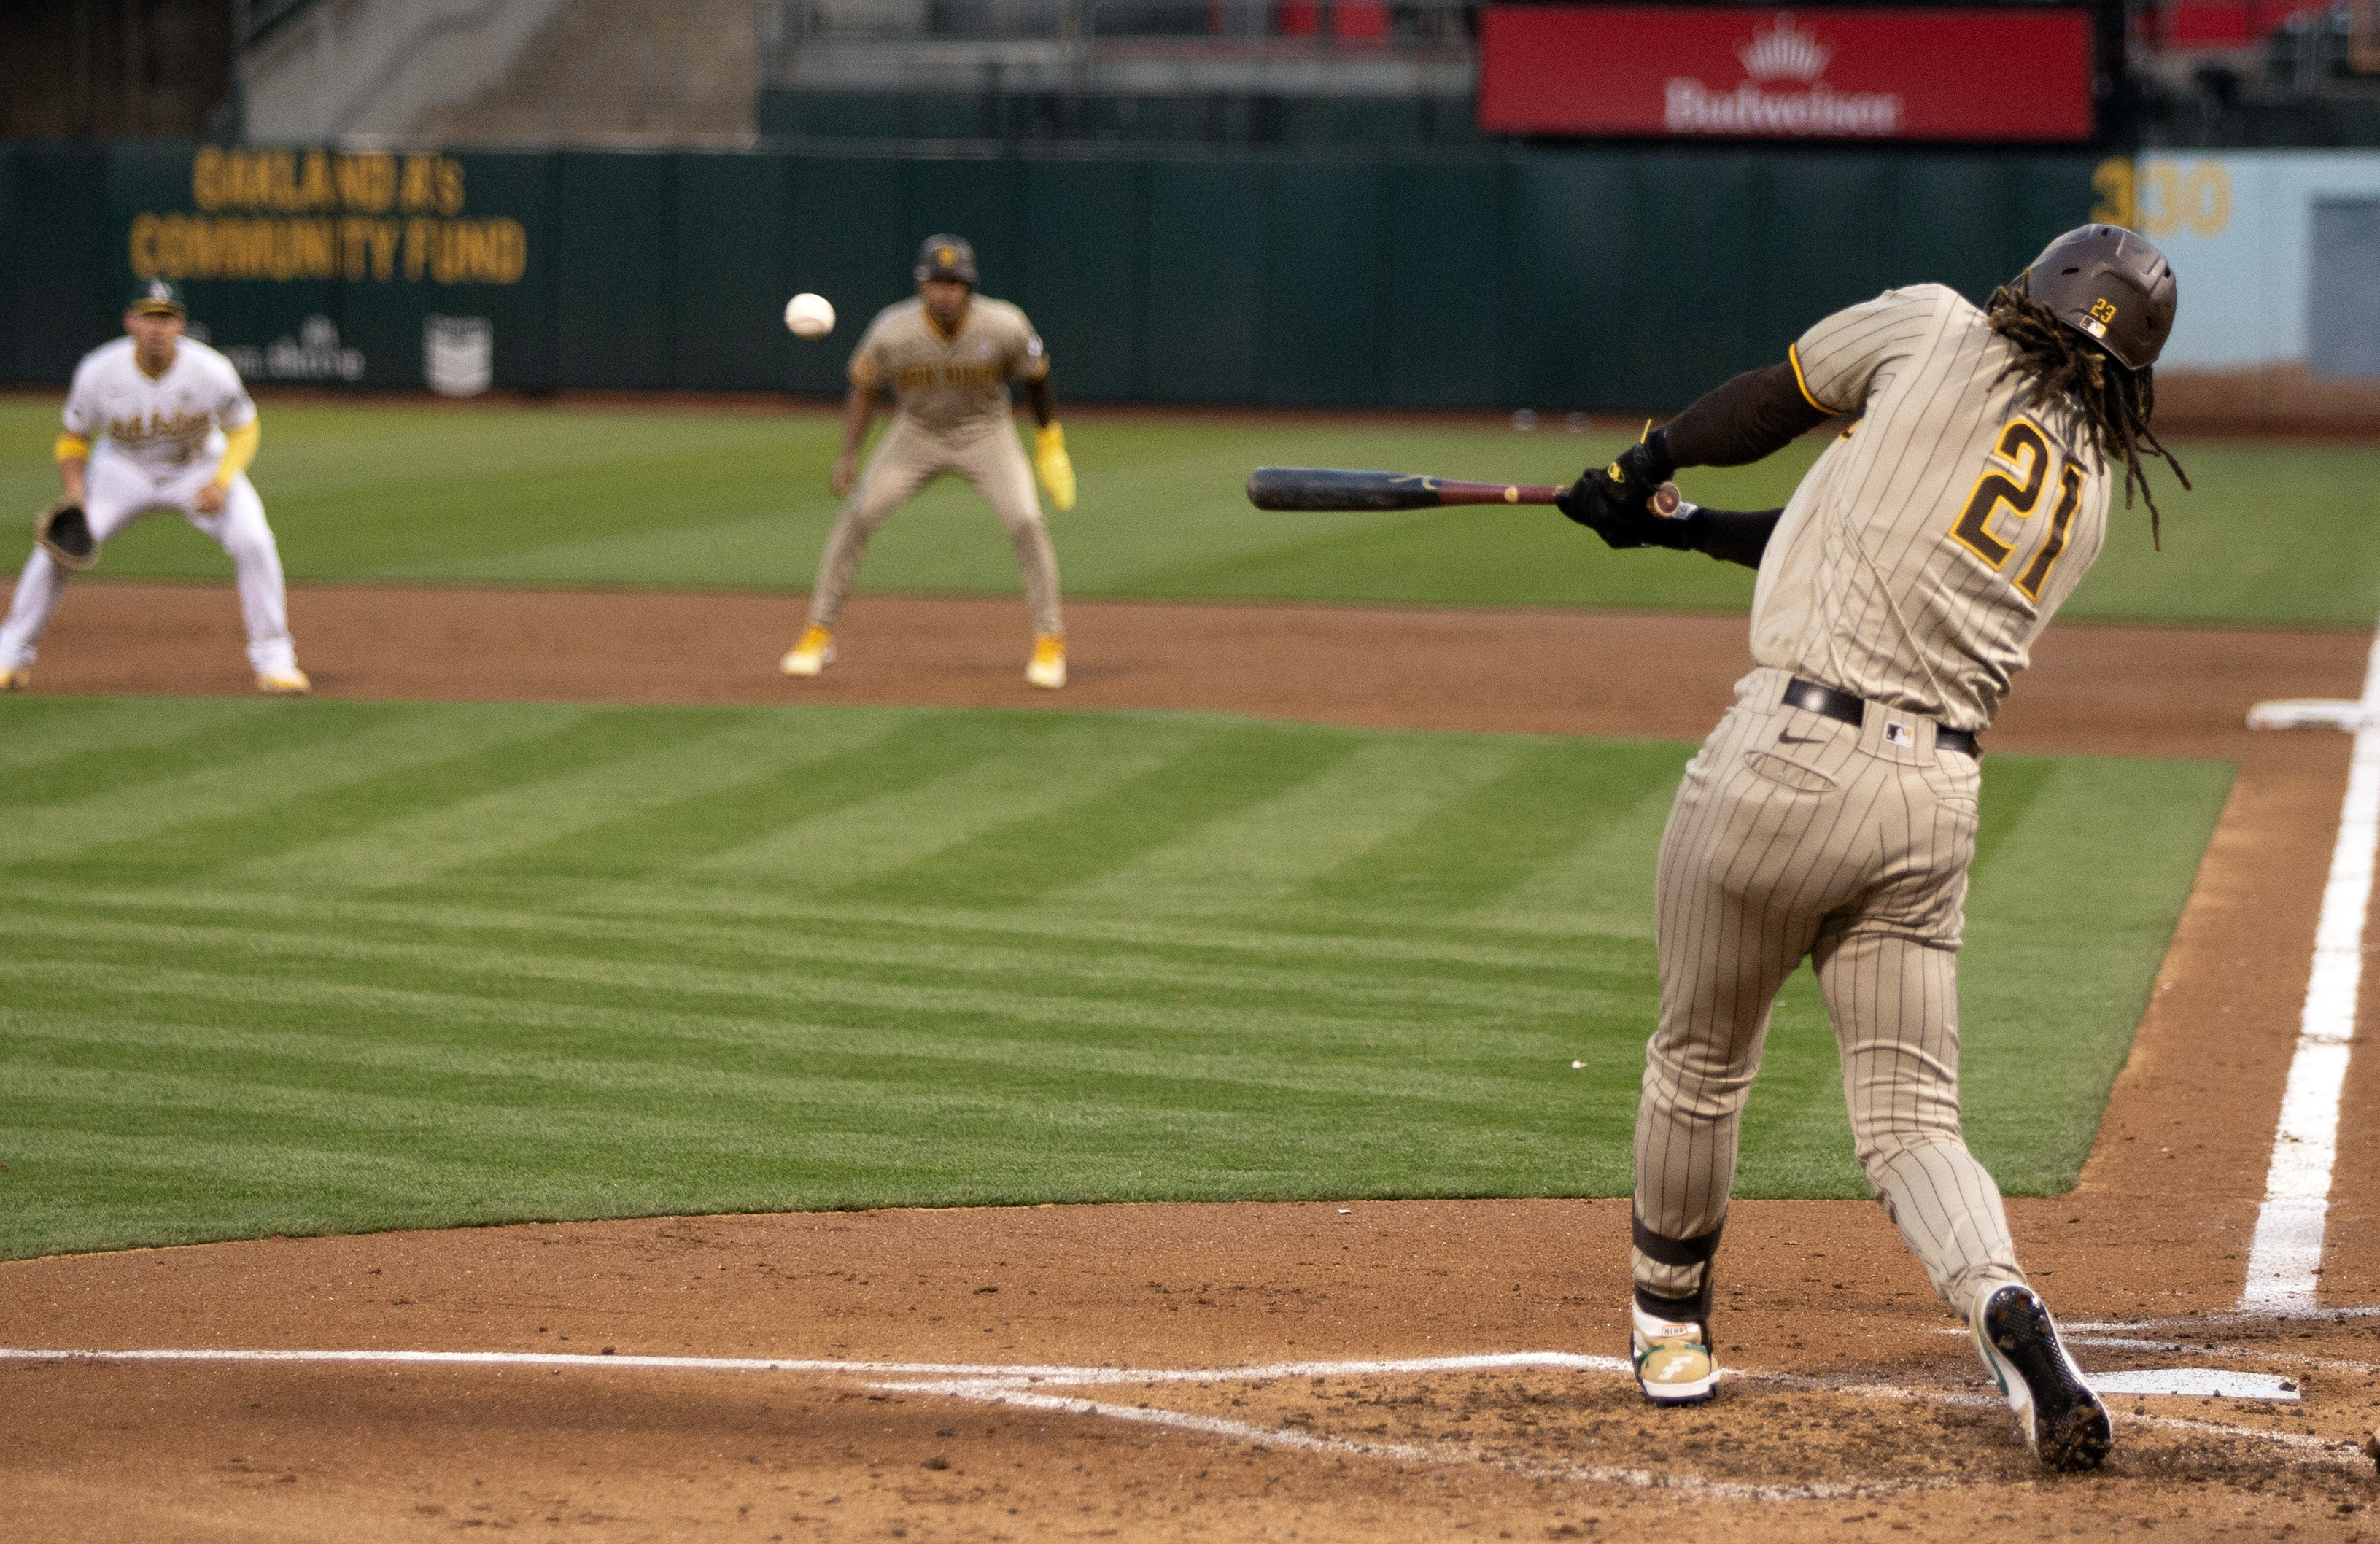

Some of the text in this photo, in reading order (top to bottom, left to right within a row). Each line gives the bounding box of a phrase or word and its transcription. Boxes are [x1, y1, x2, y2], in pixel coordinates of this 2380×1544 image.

[1664, 77, 1902, 136] Budweiser
[193, 144, 399, 214] OAKLAND
[2090, 158, 2232, 239] 330
[130, 213, 529, 286] COMMUNITY FUND
[2090, 298, 2117, 323] 23
[1948, 417, 2084, 603] 21
